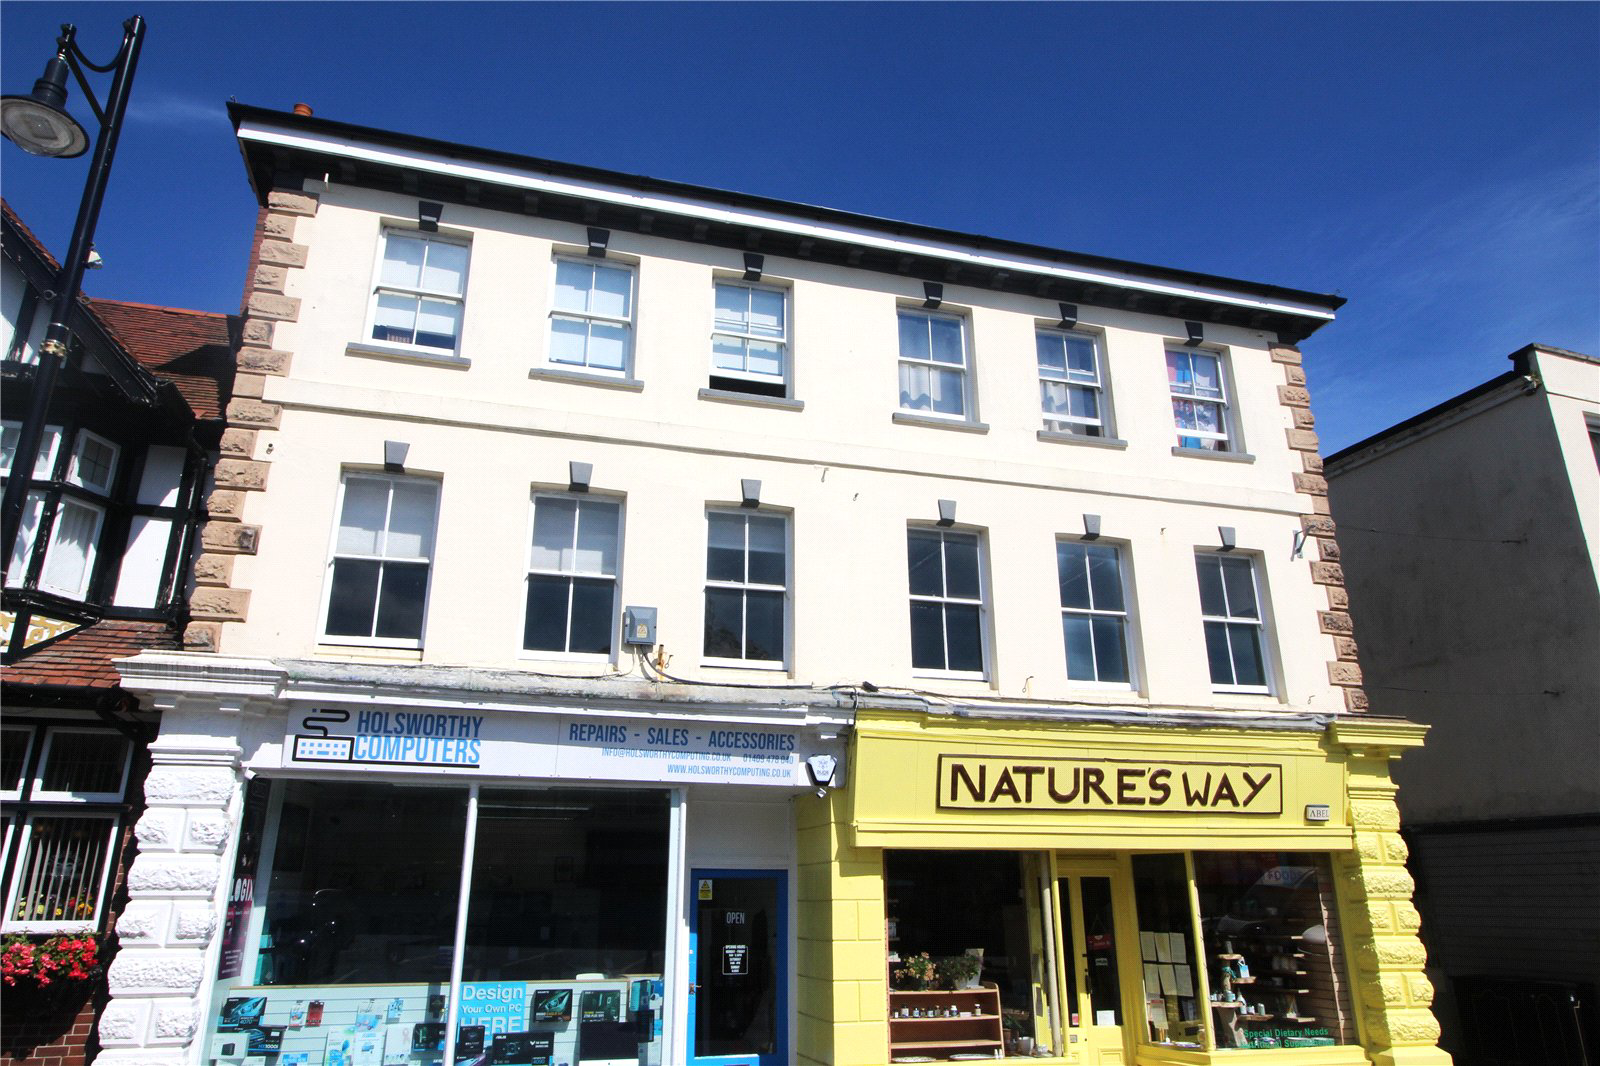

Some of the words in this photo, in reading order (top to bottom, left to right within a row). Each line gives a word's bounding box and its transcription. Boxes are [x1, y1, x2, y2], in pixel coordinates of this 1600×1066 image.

[357, 710, 484, 738] HOLSWORTHY
[569, 722, 627, 743] REPAIRS
[647, 727, 689, 747] SALES
[708, 730, 795, 751] ACCESSORIES
[354, 734, 482, 764] COMPUTERS
[667, 763, 792, 779] WWW.HOLSWORTHYCOMPUTING.CO.UK
[949, 763, 1172, 806] NATURE'S
[1181, 771, 1272, 808] WAY
[1310, 809, 1329, 818] ABEL
[726, 911, 745, 924] OPEN
[462, 984, 523, 1003] Design
[462, 1005, 484, 1014] Your
[485, 1004, 506, 1013] Own
[508, 1003, 521, 1012] PC
[1244, 1029, 1273, 1038] Special
[1275, 1028, 1303, 1038] Dietary
[1304, 1027, 1329, 1036] Needs
